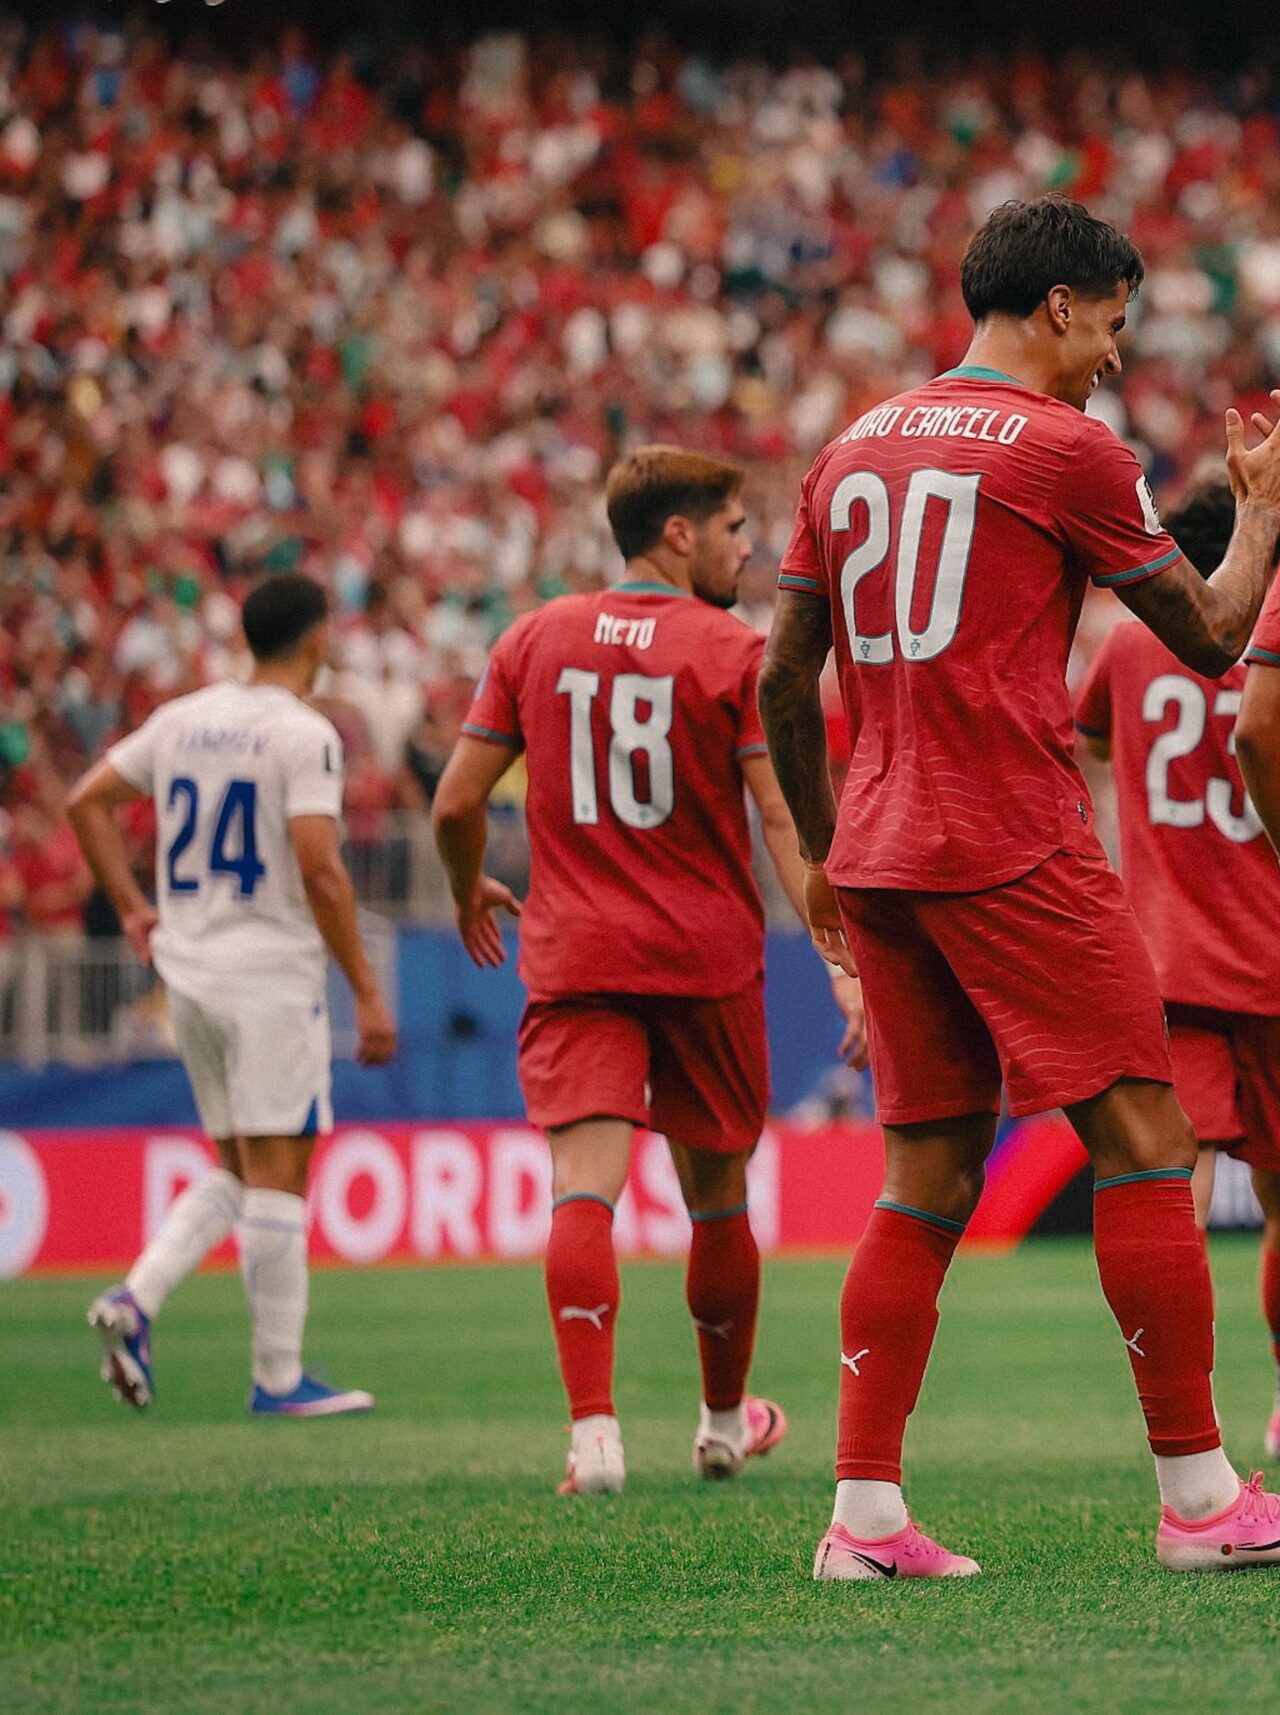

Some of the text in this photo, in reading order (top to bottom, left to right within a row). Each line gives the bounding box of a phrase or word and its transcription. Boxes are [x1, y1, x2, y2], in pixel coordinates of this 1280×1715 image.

[839, 403, 1029, 445] JOÃO CANCELO
[593, 612, 657, 650] NETO
[830, 468, 983, 665] 20
[555, 666, 675, 830] 18
[1142, 674, 1266, 844] 23
[167, 777, 267, 897] 24
